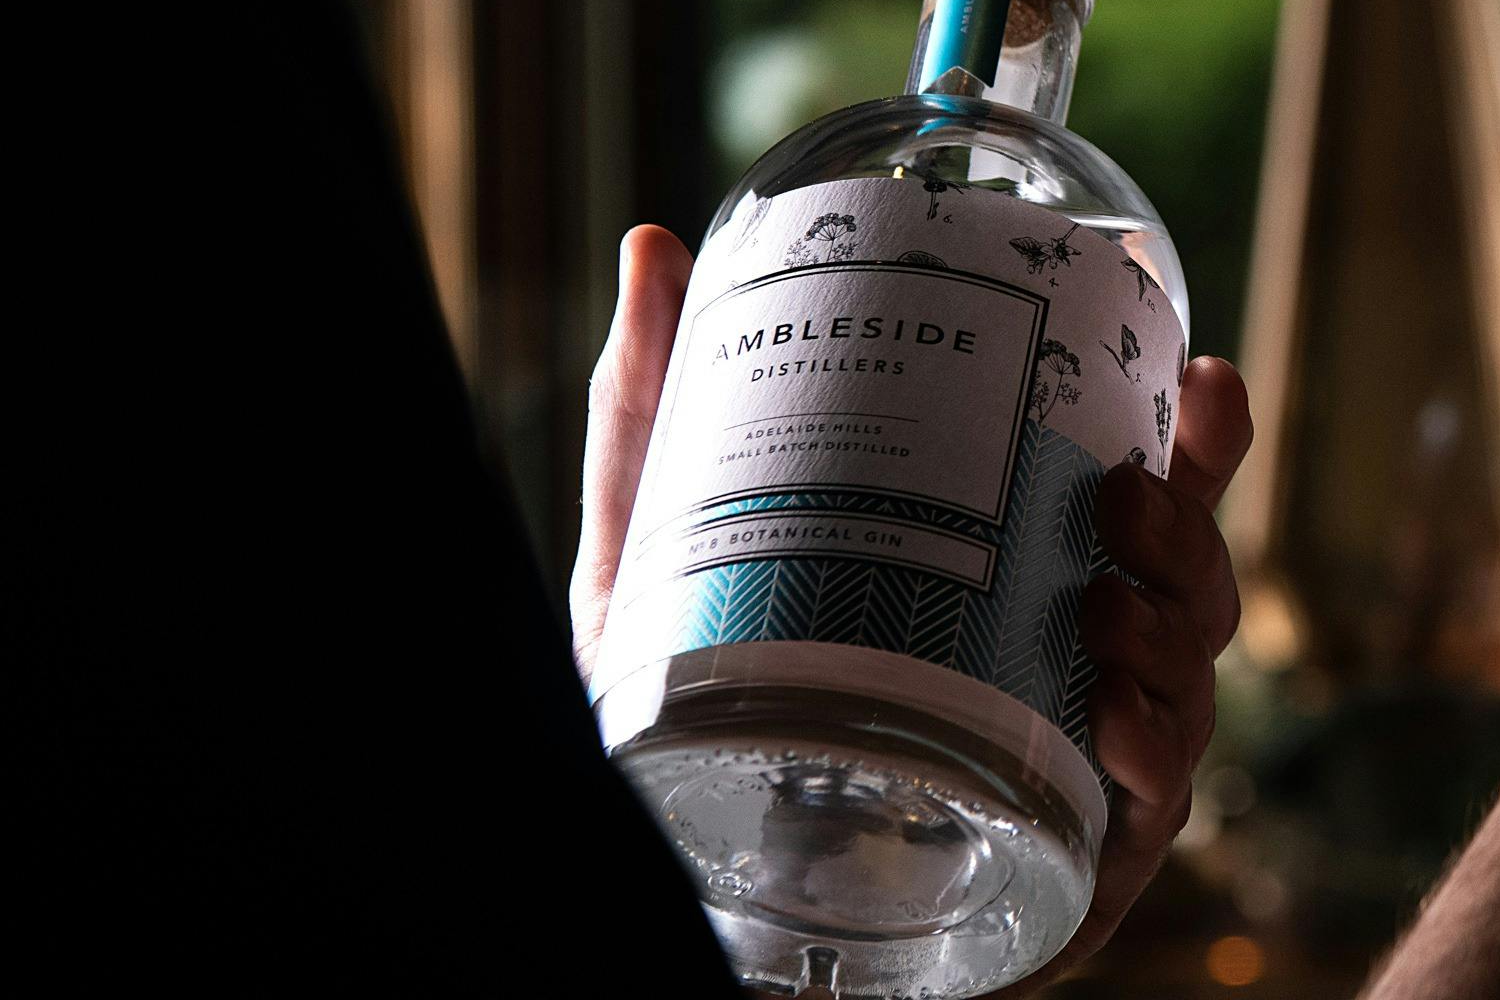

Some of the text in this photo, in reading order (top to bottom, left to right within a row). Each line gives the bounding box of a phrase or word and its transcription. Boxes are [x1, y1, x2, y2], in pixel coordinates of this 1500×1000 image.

[712, 317, 977, 366] AMBLESIDE
[750, 358, 906, 382] DISTILLERS
[744, 423, 883, 441] ADELAIDE HILLS
[717, 441, 911, 465] SMALL BATCH DISTILLED
[708, 537, 719, 549] 8
[729, 526, 853, 545] BOTANICAL
[864, 530, 904, 548] GIN
